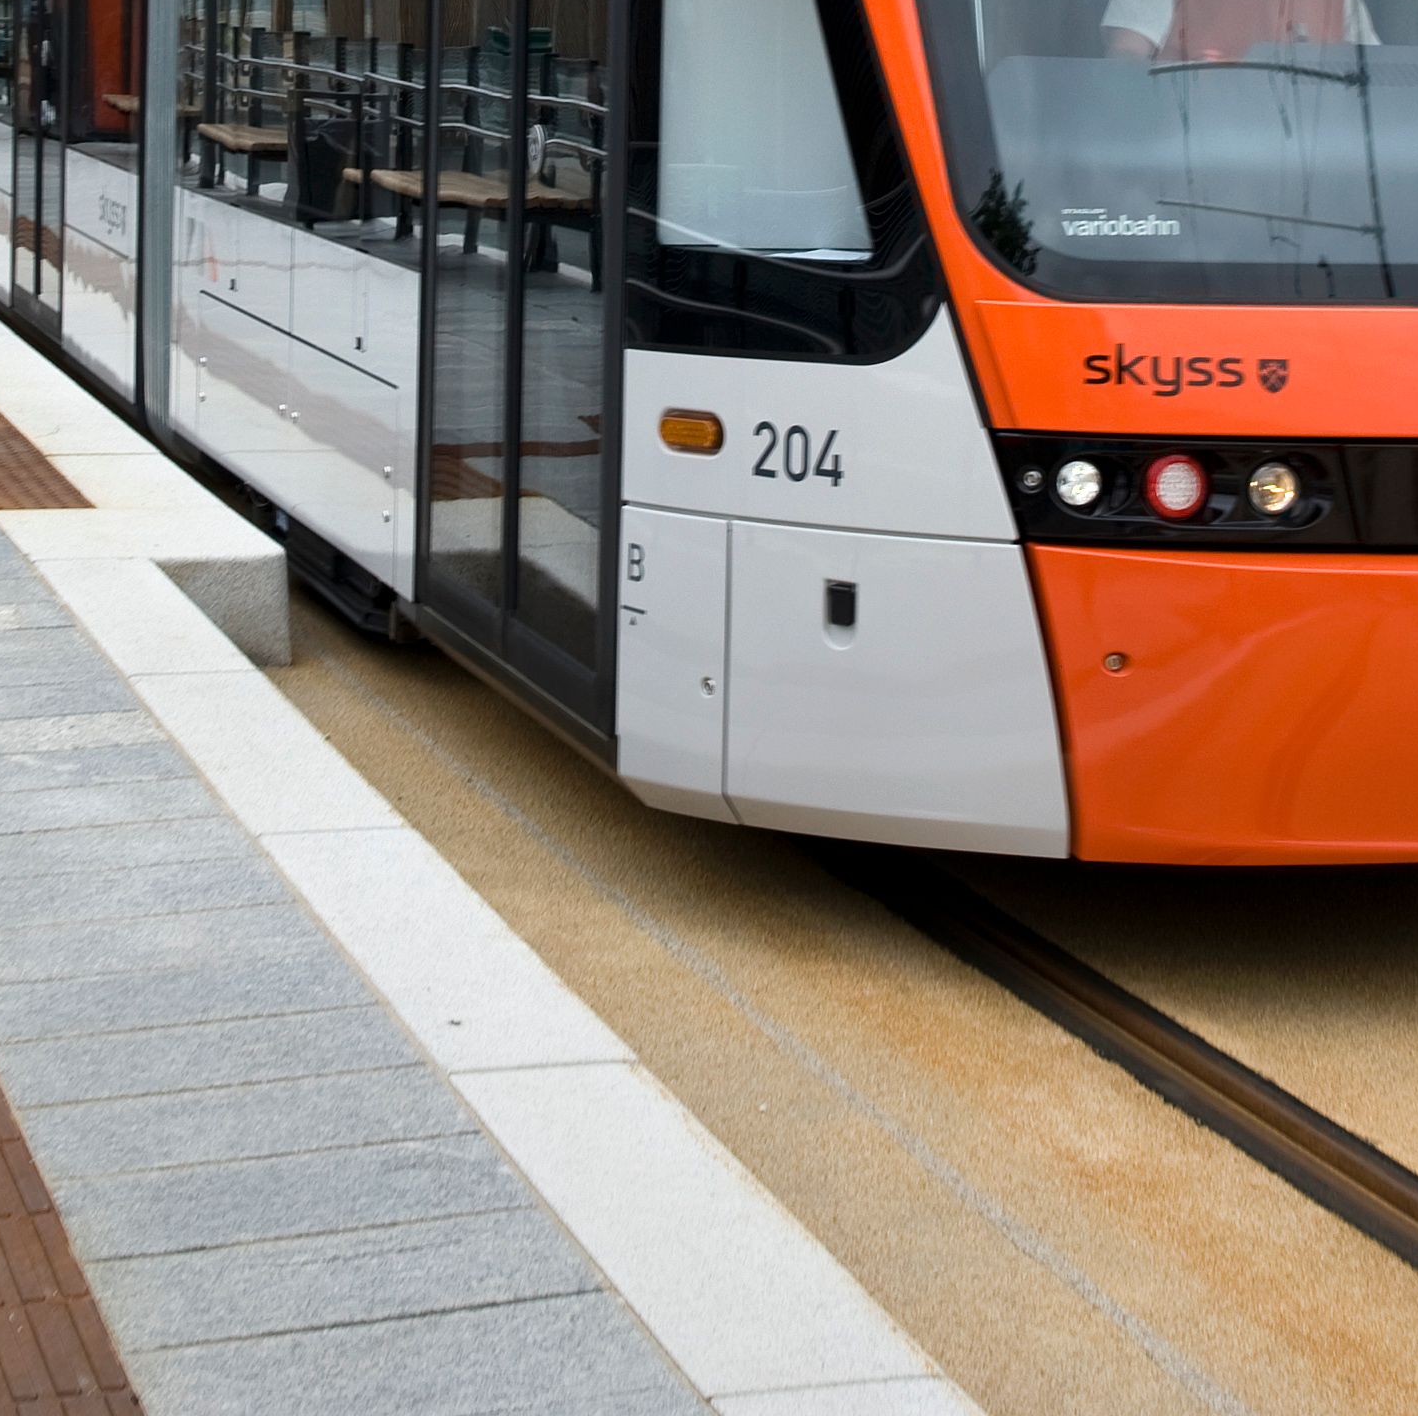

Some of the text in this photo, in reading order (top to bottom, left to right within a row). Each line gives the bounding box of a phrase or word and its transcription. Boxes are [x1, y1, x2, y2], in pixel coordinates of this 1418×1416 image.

[1061, 214, 1181, 236] variobahn
[1084, 343, 1243, 397] skyss
[752, 421, 844, 487] 204
[627, 542, 645, 582] B
